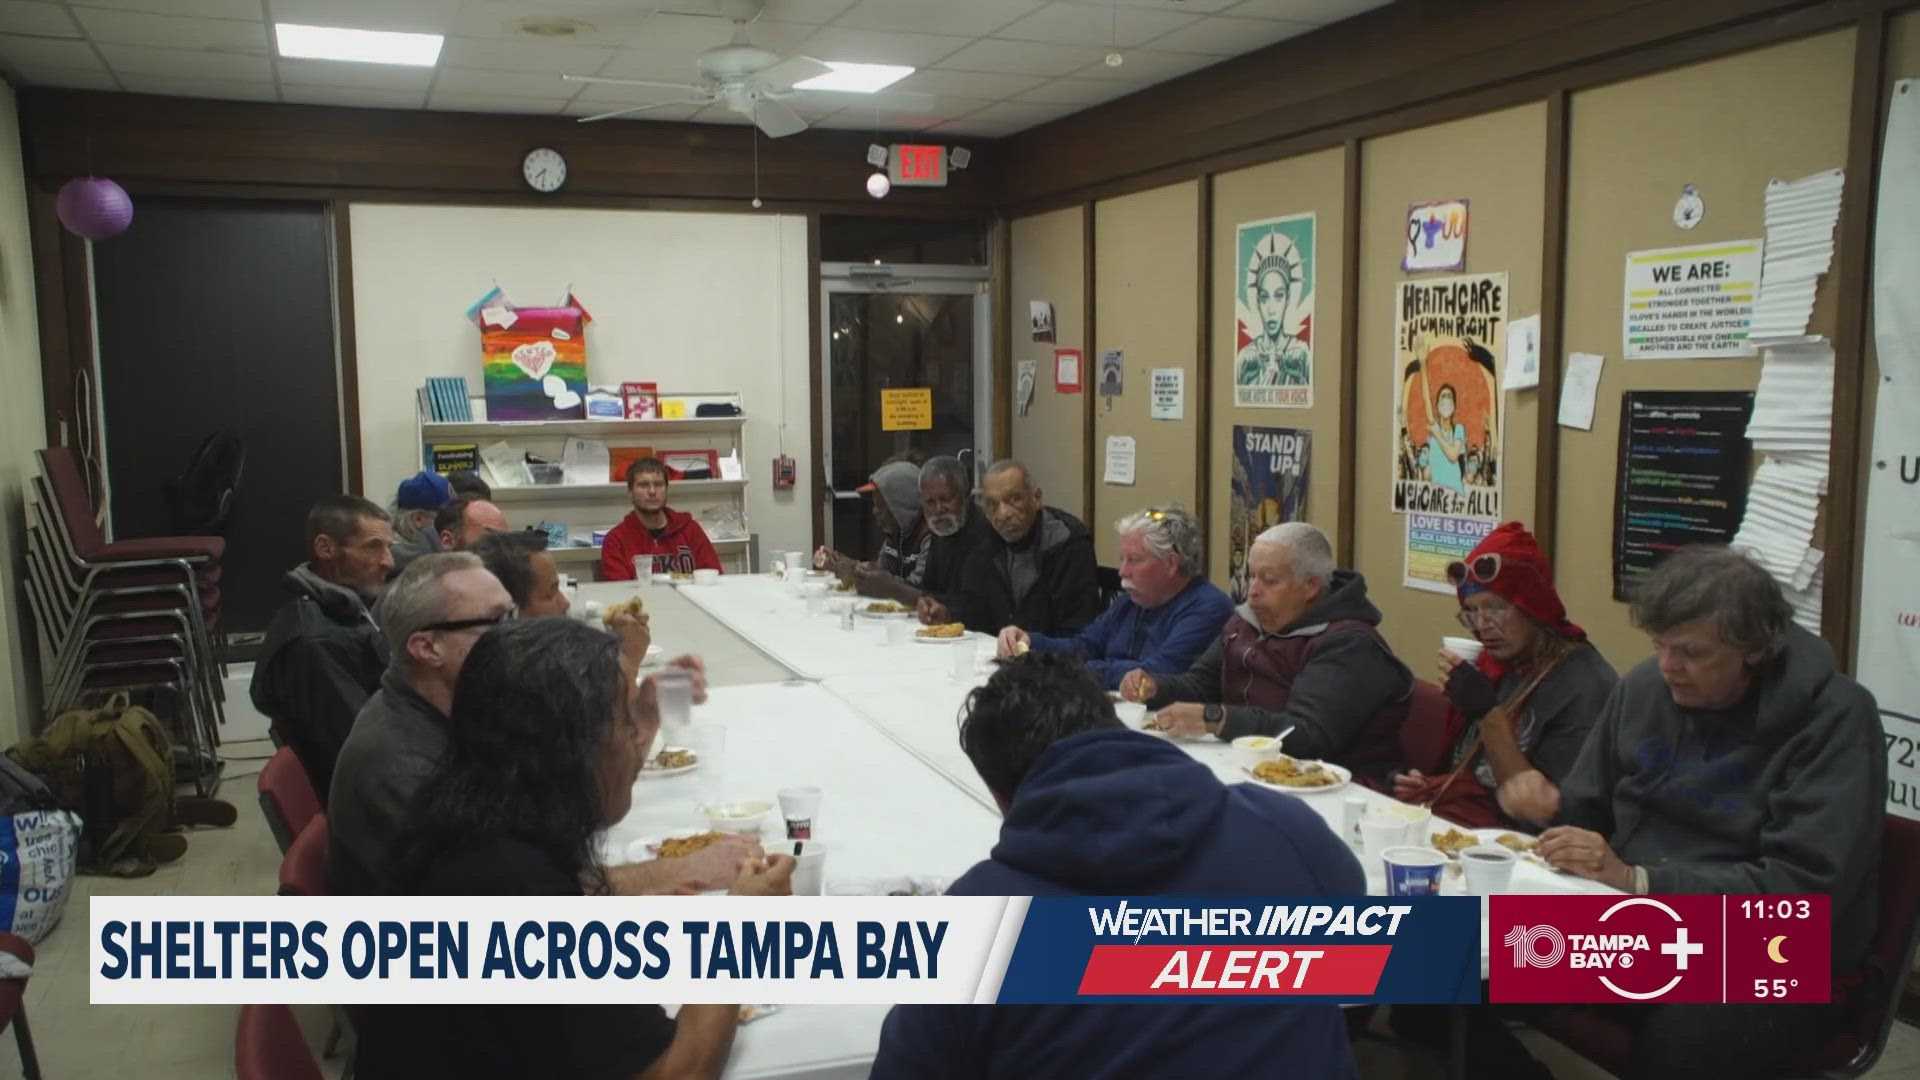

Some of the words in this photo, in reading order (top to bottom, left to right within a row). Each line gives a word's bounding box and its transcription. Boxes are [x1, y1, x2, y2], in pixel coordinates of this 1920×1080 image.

[901, 146, 943, 178] EXIT
[1652, 264, 1682, 283] WE
[1687, 260, 1731, 280] ARE:
[1659, 287, 1675, 296] ALL
[1675, 284, 1721, 295] CONNECTED
[1648, 299, 1689, 309] STRONGER
[1690, 297, 1732, 307] TOGETHER
[1699, 307, 1714, 317] THE
[1638, 323, 1666, 333] CALLED
[1667, 322, 1678, 332] TO
[1680, 321, 1708, 331] CREATE
[1710, 318, 1742, 330] JUSTICE
[1408, 317, 1454, 352] HUMAN
[1646, 334, 1696, 343] RESPONSIBLE
[1697, 333, 1713, 342] FOR
[1640, 342, 1676, 352] ANOTHER
[1676, 341, 1693, 351] AND
[1695, 341, 1709, 350] THE
[1710, 340, 1740, 349] EARTH
[1245, 432, 1295, 454] STAND
[1467, 489, 1499, 517] ALL!
[1411, 514, 1441, 531] LOVE
[1443, 519, 1456, 532] IS
[1457, 520, 1491, 537] LOVE
[1411, 530, 1434, 541] BLACK
[1436, 534, 1457, 545] LIVES
